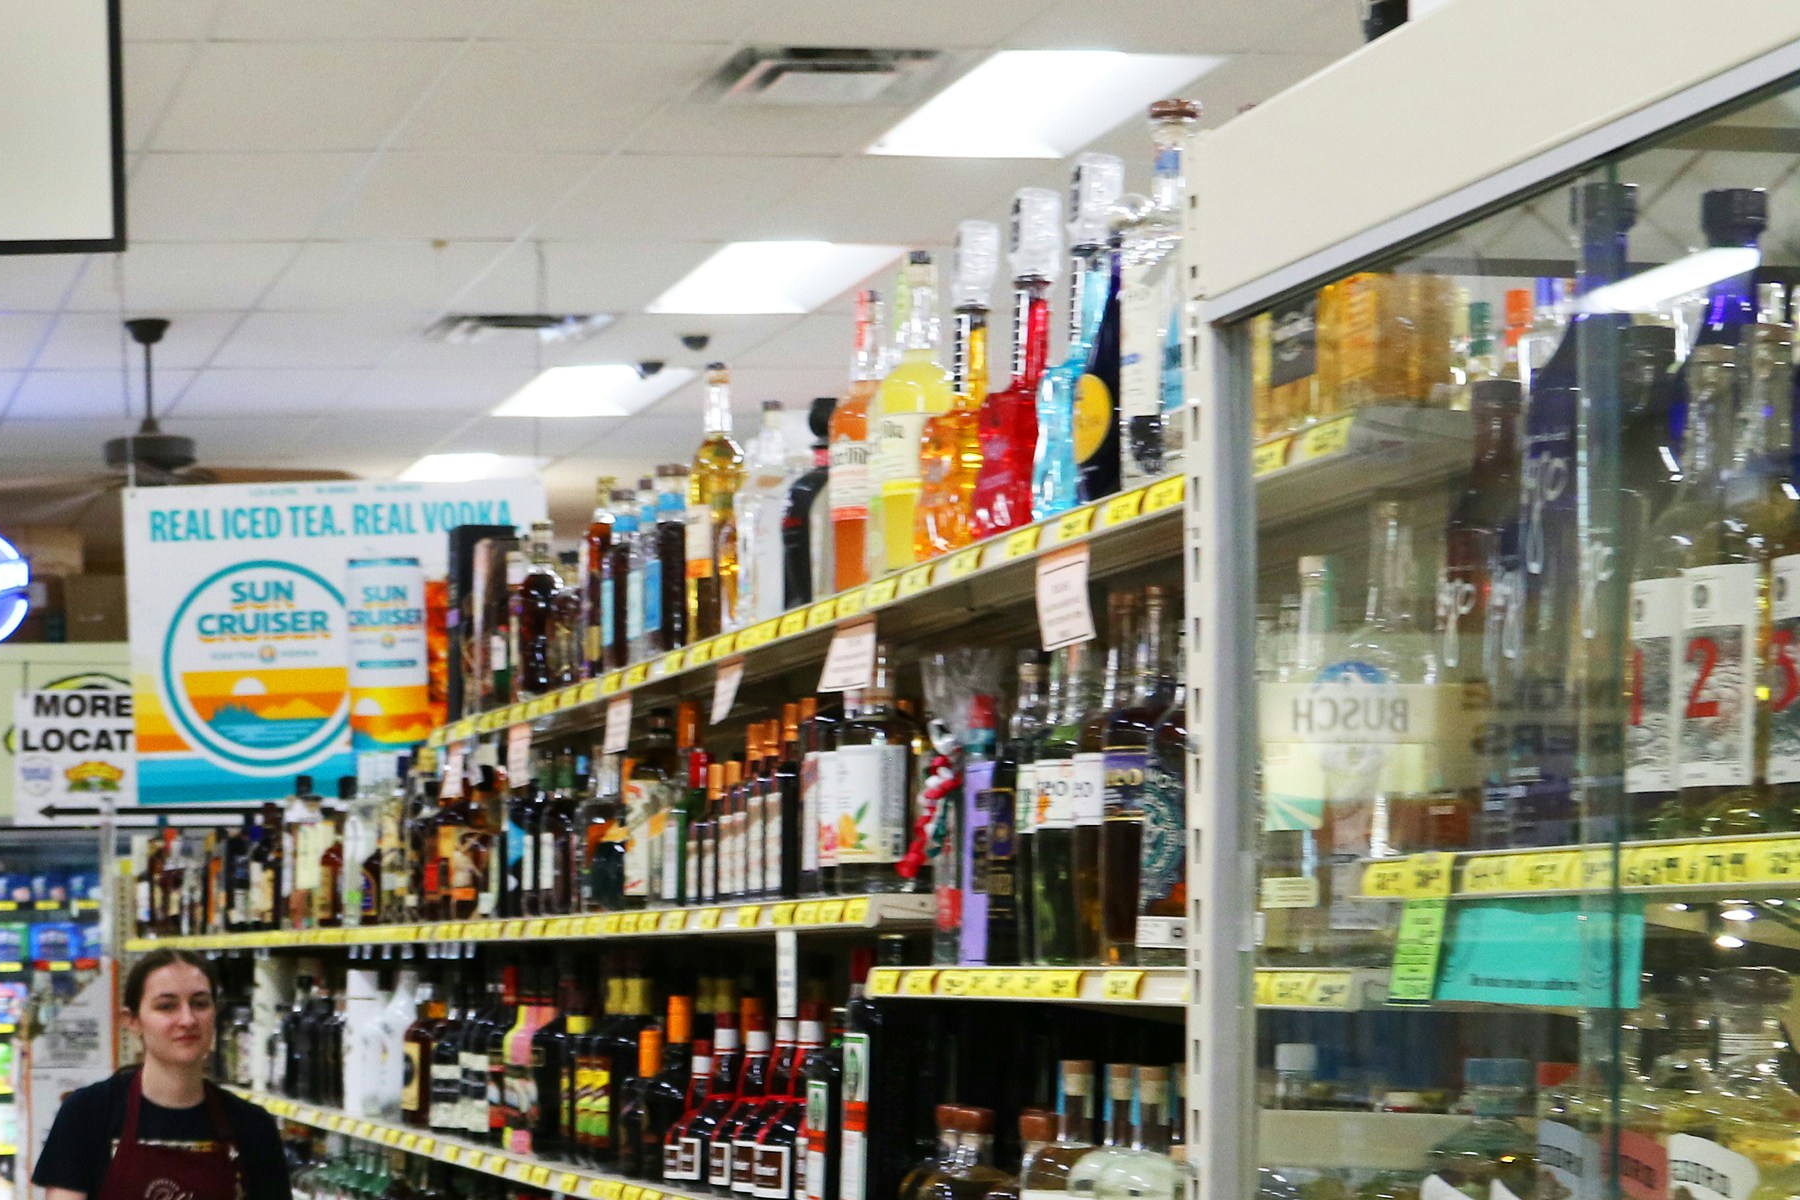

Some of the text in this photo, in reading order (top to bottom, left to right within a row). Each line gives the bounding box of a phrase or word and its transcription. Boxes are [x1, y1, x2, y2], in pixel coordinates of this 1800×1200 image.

[149, 508, 213, 543] REAL
[223, 506, 282, 541] ICED
[288, 504, 346, 539] TEA.
[353, 502, 418, 536] REAL
[229, 580, 295, 603] SUN
[362, 585, 409, 603] SUN
[196, 610, 331, 636] CRUISER
[1684, 636, 1720, 719] 2
[33, 693, 132, 719] MORE
